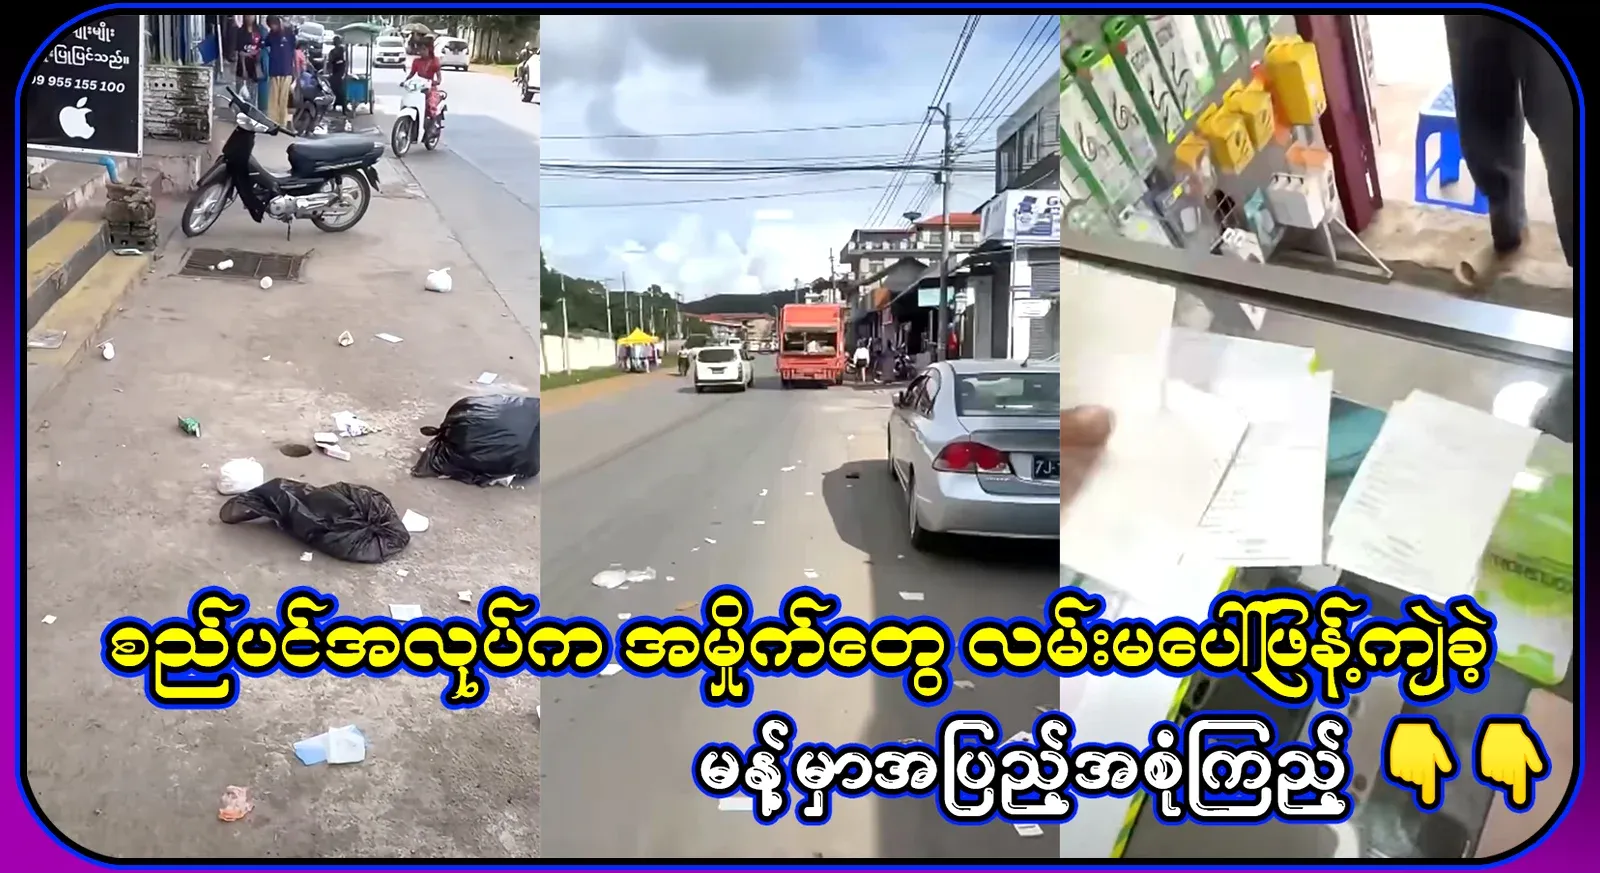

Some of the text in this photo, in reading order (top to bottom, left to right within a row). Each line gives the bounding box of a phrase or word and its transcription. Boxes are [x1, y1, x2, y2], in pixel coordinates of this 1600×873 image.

[48, 76, 72, 88] 955
[74, 79, 97, 90] 155
[99, 81, 125, 93] 100
